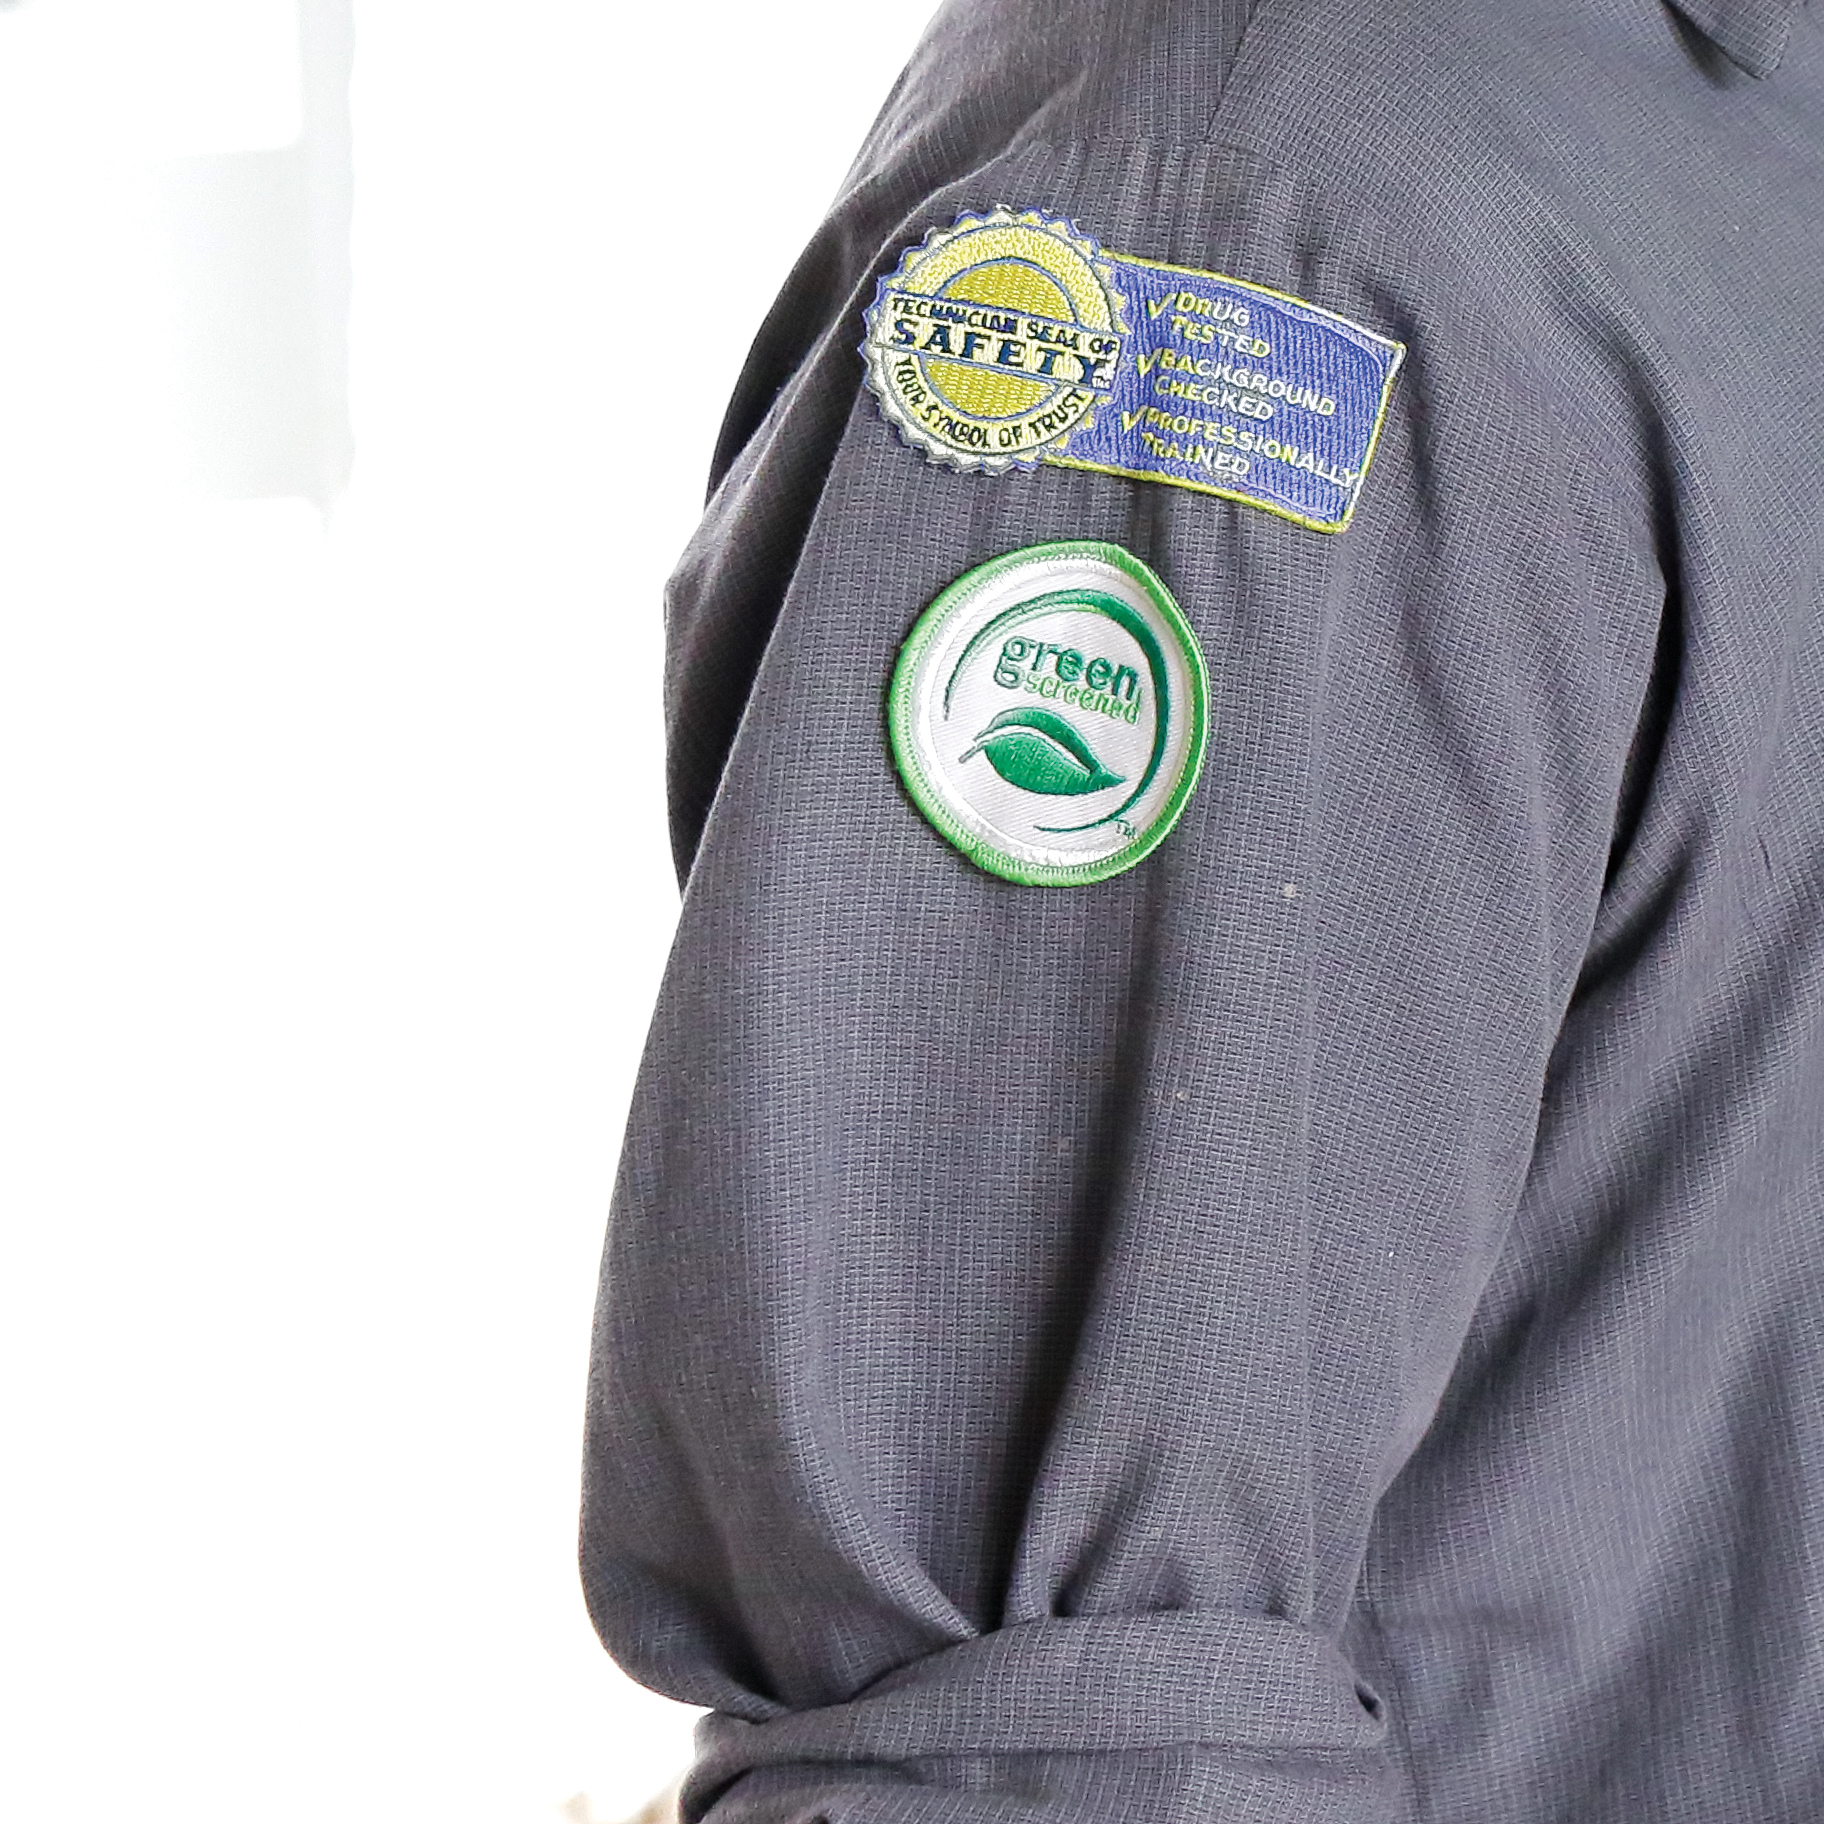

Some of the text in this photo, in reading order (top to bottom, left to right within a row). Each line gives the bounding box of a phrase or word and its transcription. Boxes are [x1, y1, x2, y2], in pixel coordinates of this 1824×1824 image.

[892, 297, 1117, 354] TECHNICIAN SEAL OF
[1171, 315, 1271, 358] TESTED
[1175, 292, 1250, 326] DRUG
[891, 318, 1100, 384] SAFETY
[896, 359, 1086, 447] YOUR SYMBOL OF TRUST
[1154, 376, 1274, 422] CHECKED
[1159, 347, 1336, 416] BACKGROUND
[1141, 432, 1250, 476] TRAINED
[1144, 406, 1359, 488] PROFESSIONALLY
[994, 636, 1139, 700] green
[1023, 676, 1141, 725] screened
